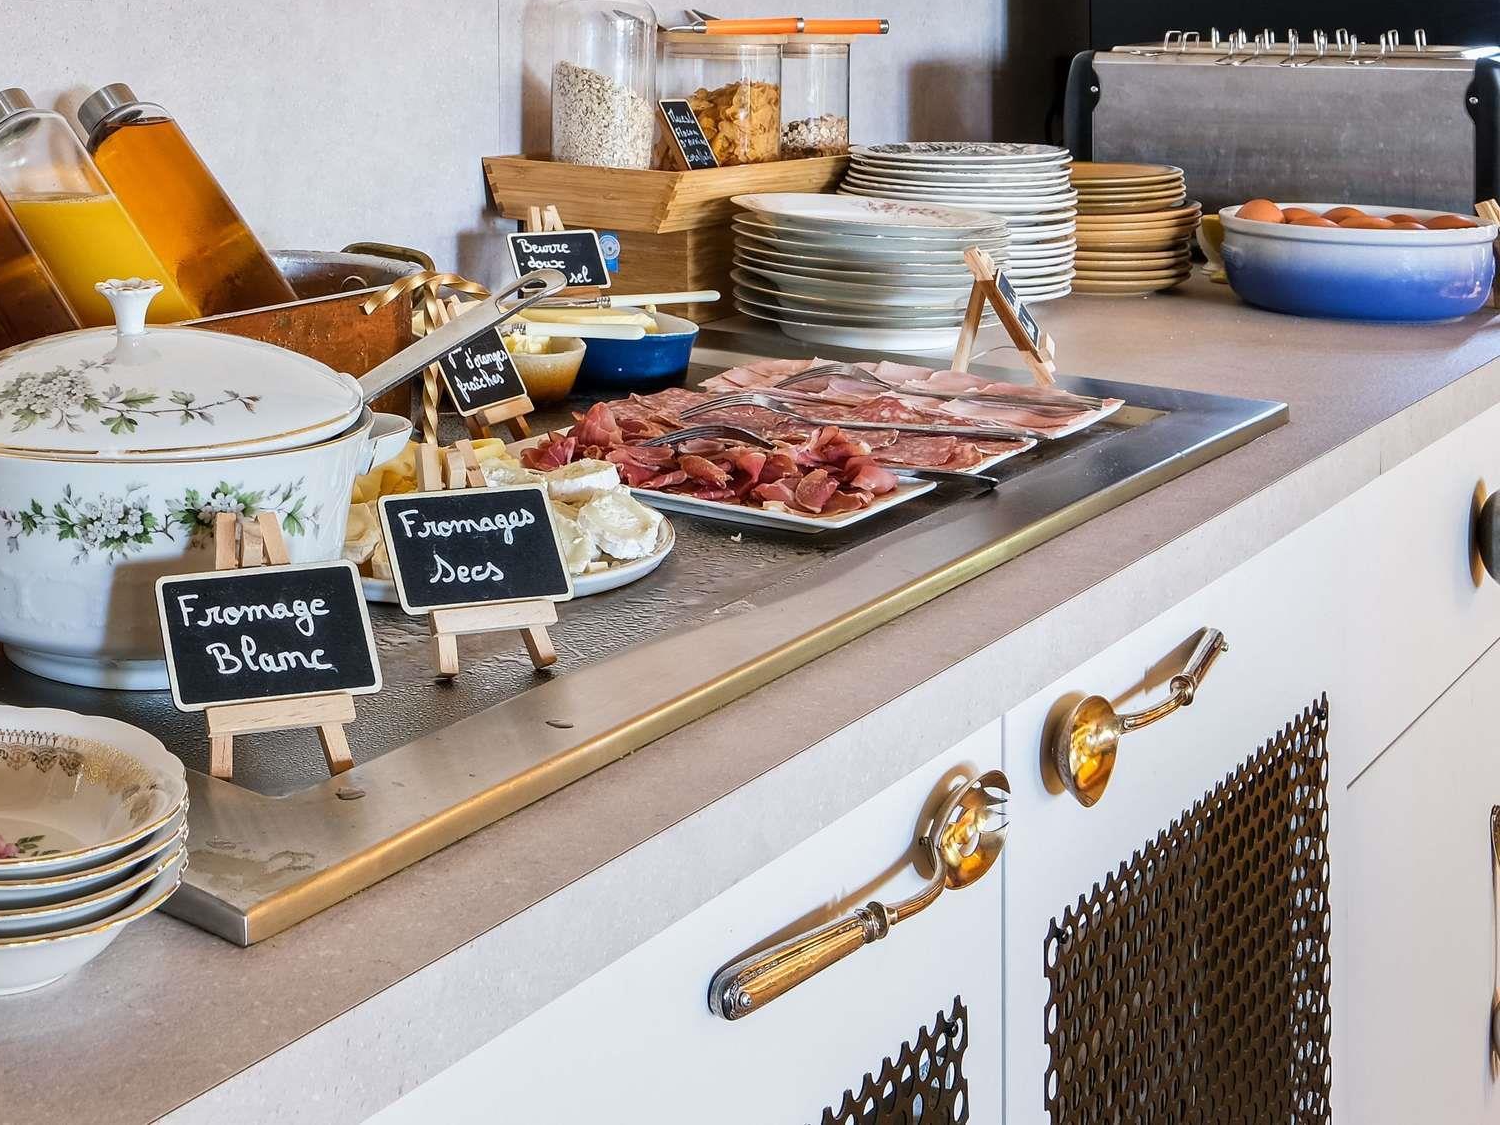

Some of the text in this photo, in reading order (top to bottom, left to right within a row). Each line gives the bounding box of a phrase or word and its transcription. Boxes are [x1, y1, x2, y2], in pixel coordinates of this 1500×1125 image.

[516, 238, 571, 254] Beurre
[464, 347, 508, 371] d'oranges
[398, 507, 535, 546] Fromages
[177, 594, 331, 637] Fromage
[205, 634, 334, 675] Blanc
